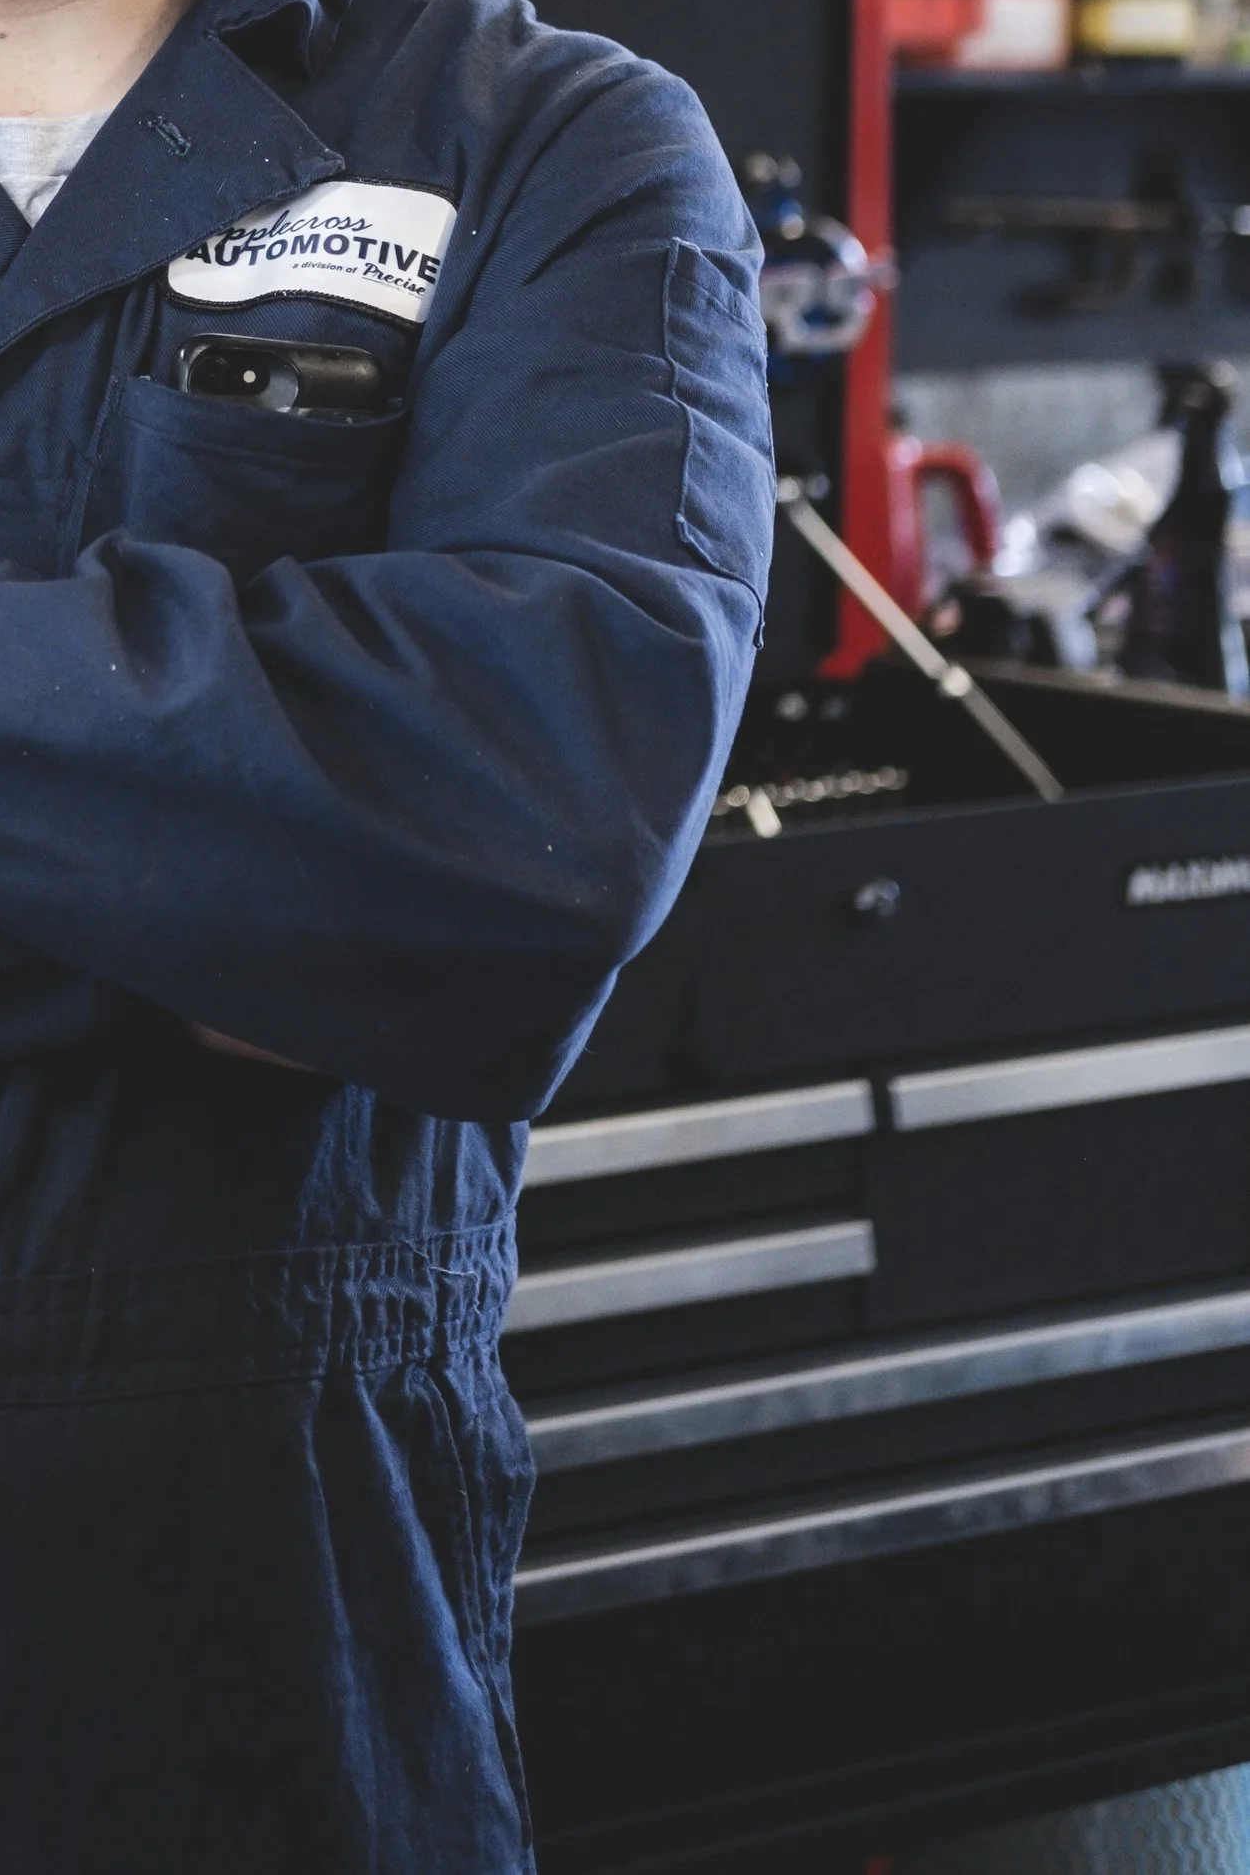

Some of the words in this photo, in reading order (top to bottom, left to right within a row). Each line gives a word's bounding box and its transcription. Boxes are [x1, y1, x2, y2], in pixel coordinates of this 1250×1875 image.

[216, 209, 373, 253] pplecross
[184, 234, 441, 285] AUTOMOTIVE
[292, 262, 299, 270] a
[301, 261, 343, 272] division
[345, 266, 358, 274] of
[361, 262, 426, 296] Precise
